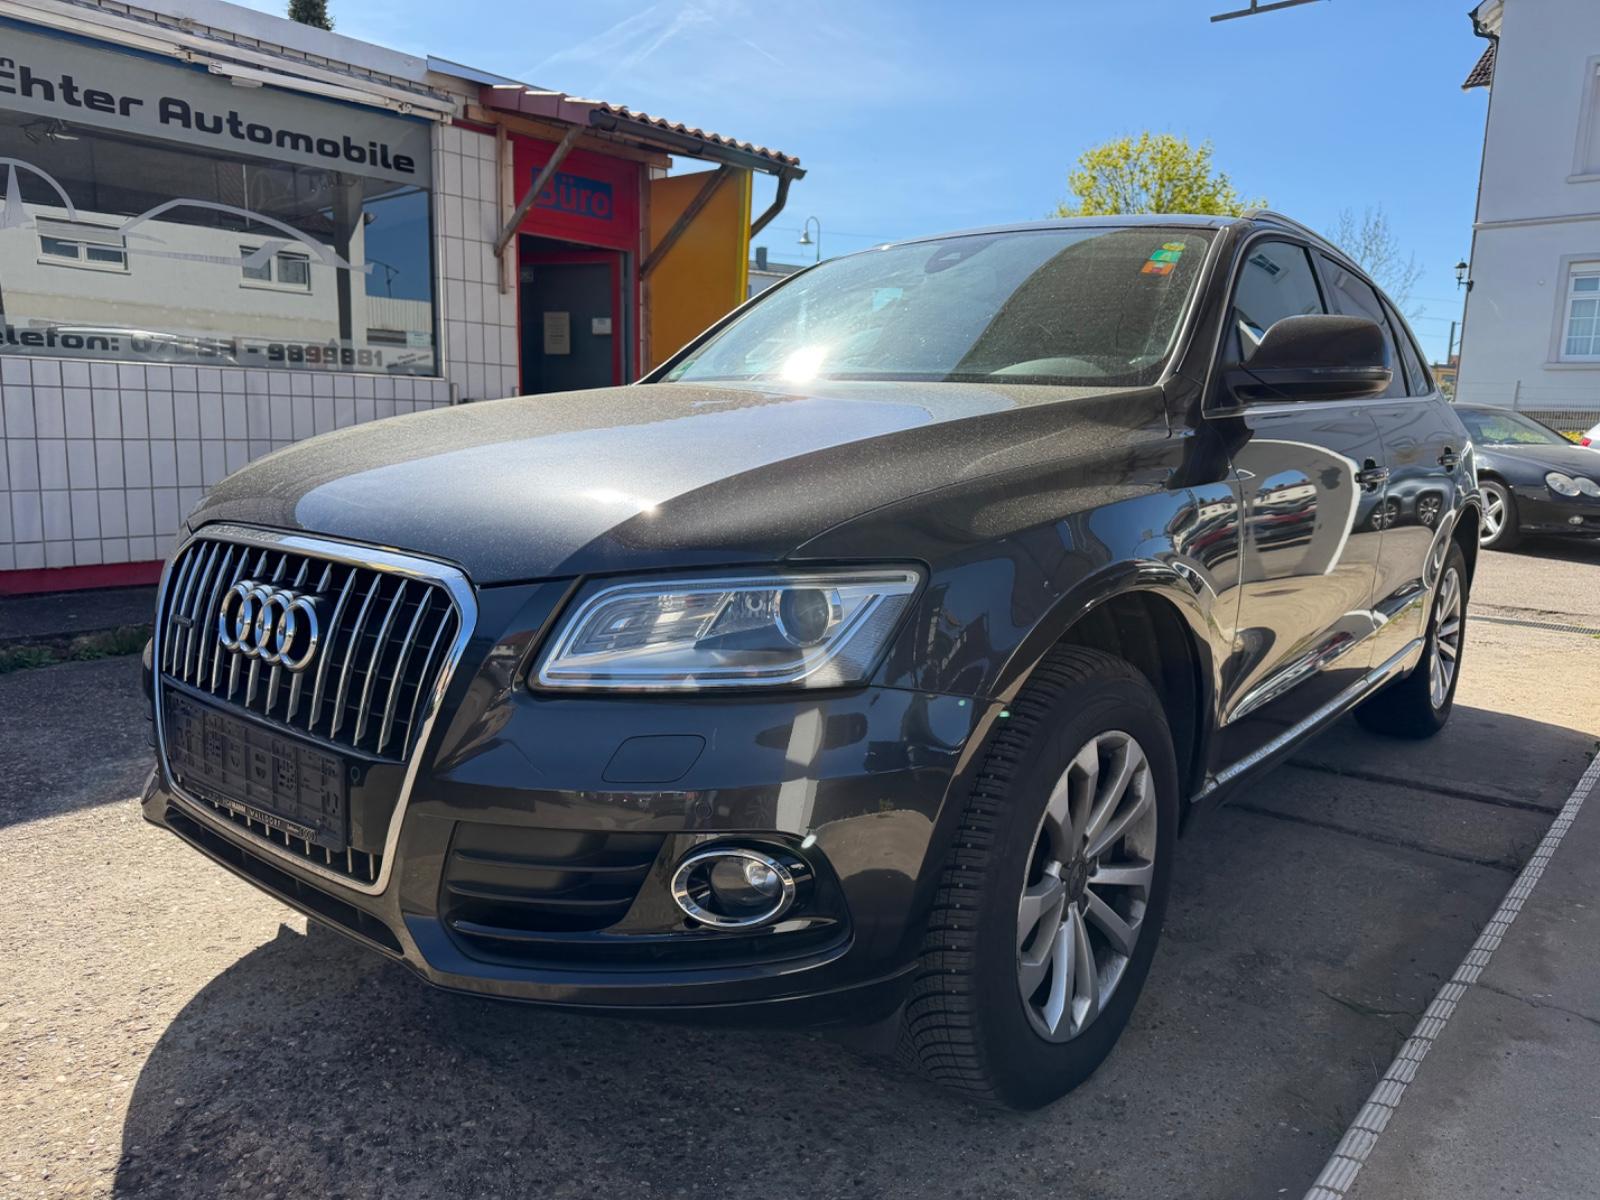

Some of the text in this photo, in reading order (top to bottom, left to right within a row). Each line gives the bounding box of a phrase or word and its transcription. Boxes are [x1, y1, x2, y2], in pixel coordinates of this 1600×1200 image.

[158, 96, 416, 174] Automobile
[535, 172, 609, 216] Büro
[0, 324, 119, 351] lefon:
[267, 343, 382, 367] 9899881
